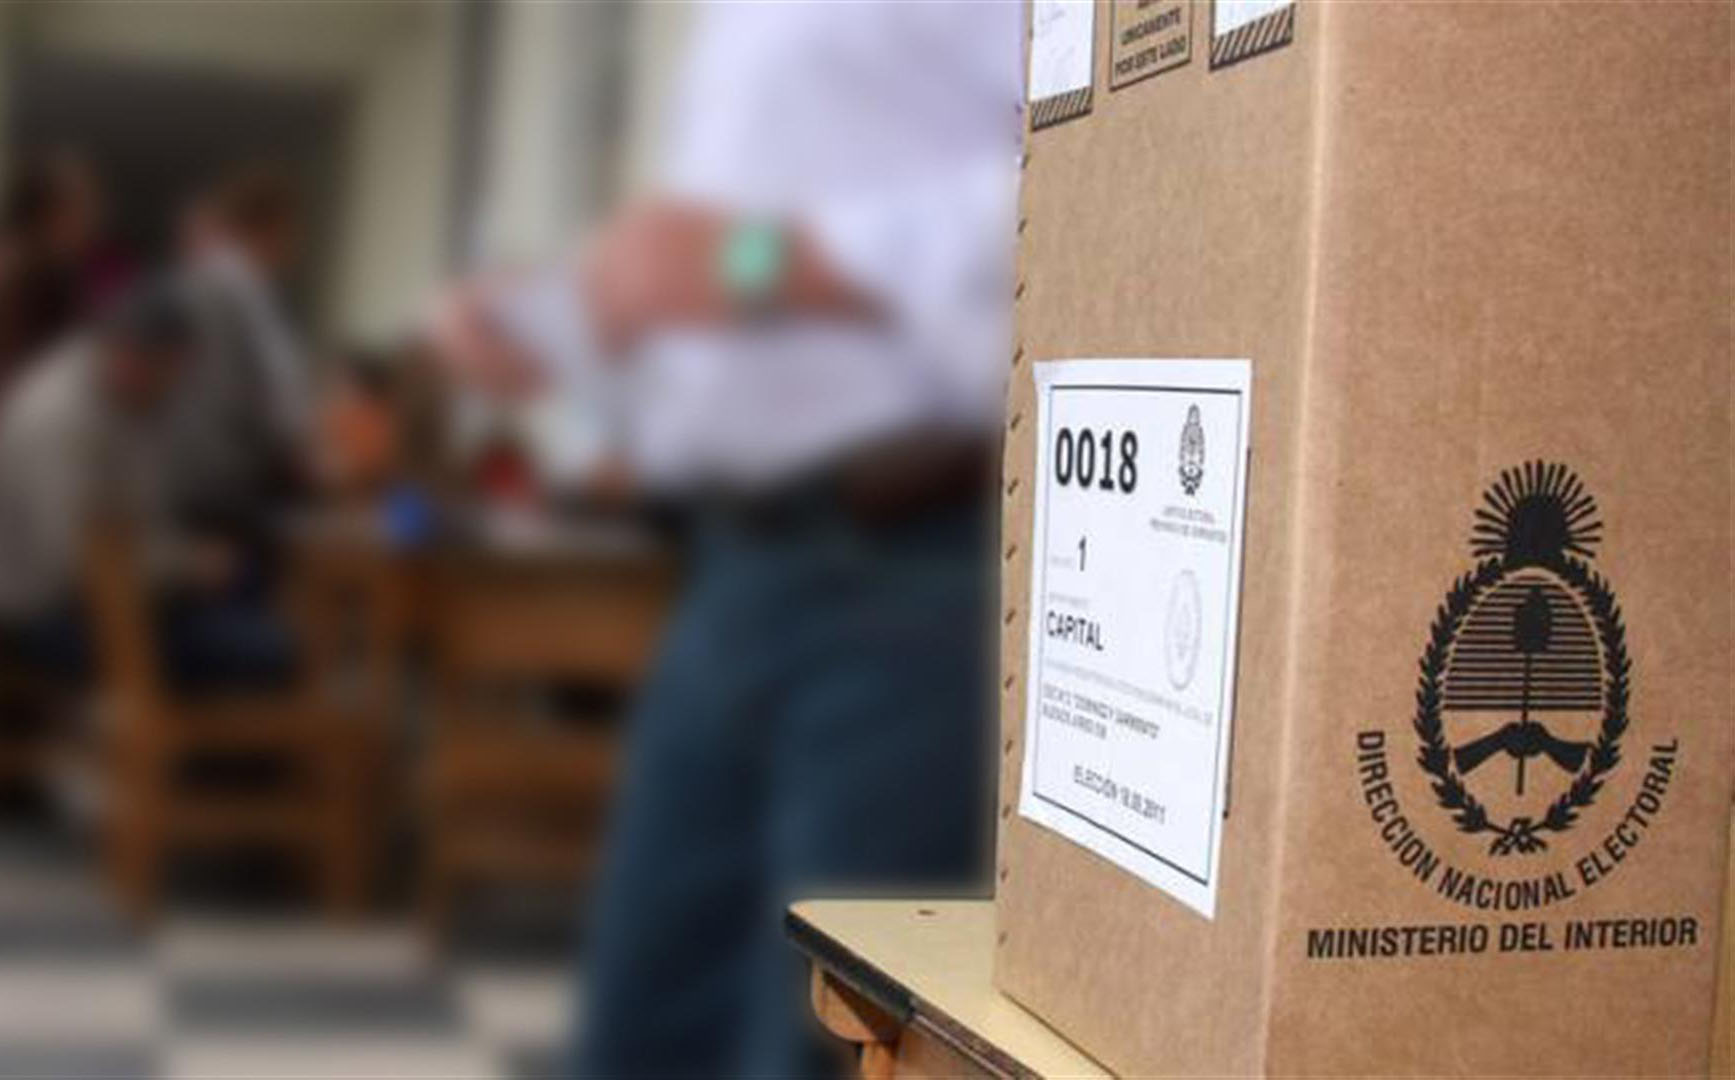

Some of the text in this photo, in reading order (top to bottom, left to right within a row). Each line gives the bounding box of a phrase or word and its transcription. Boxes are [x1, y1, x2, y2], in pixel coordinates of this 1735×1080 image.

[1056, 427, 1138, 494] 0018
[1079, 536, 1086, 571] 1
[1047, 610, 1104, 651] CAPITAL
[1357, 729, 1679, 911] DIRECCION NACIONAL ELECTORAL
[1307, 917, 1698, 958] MINISTERIO DEL INTERIOR
